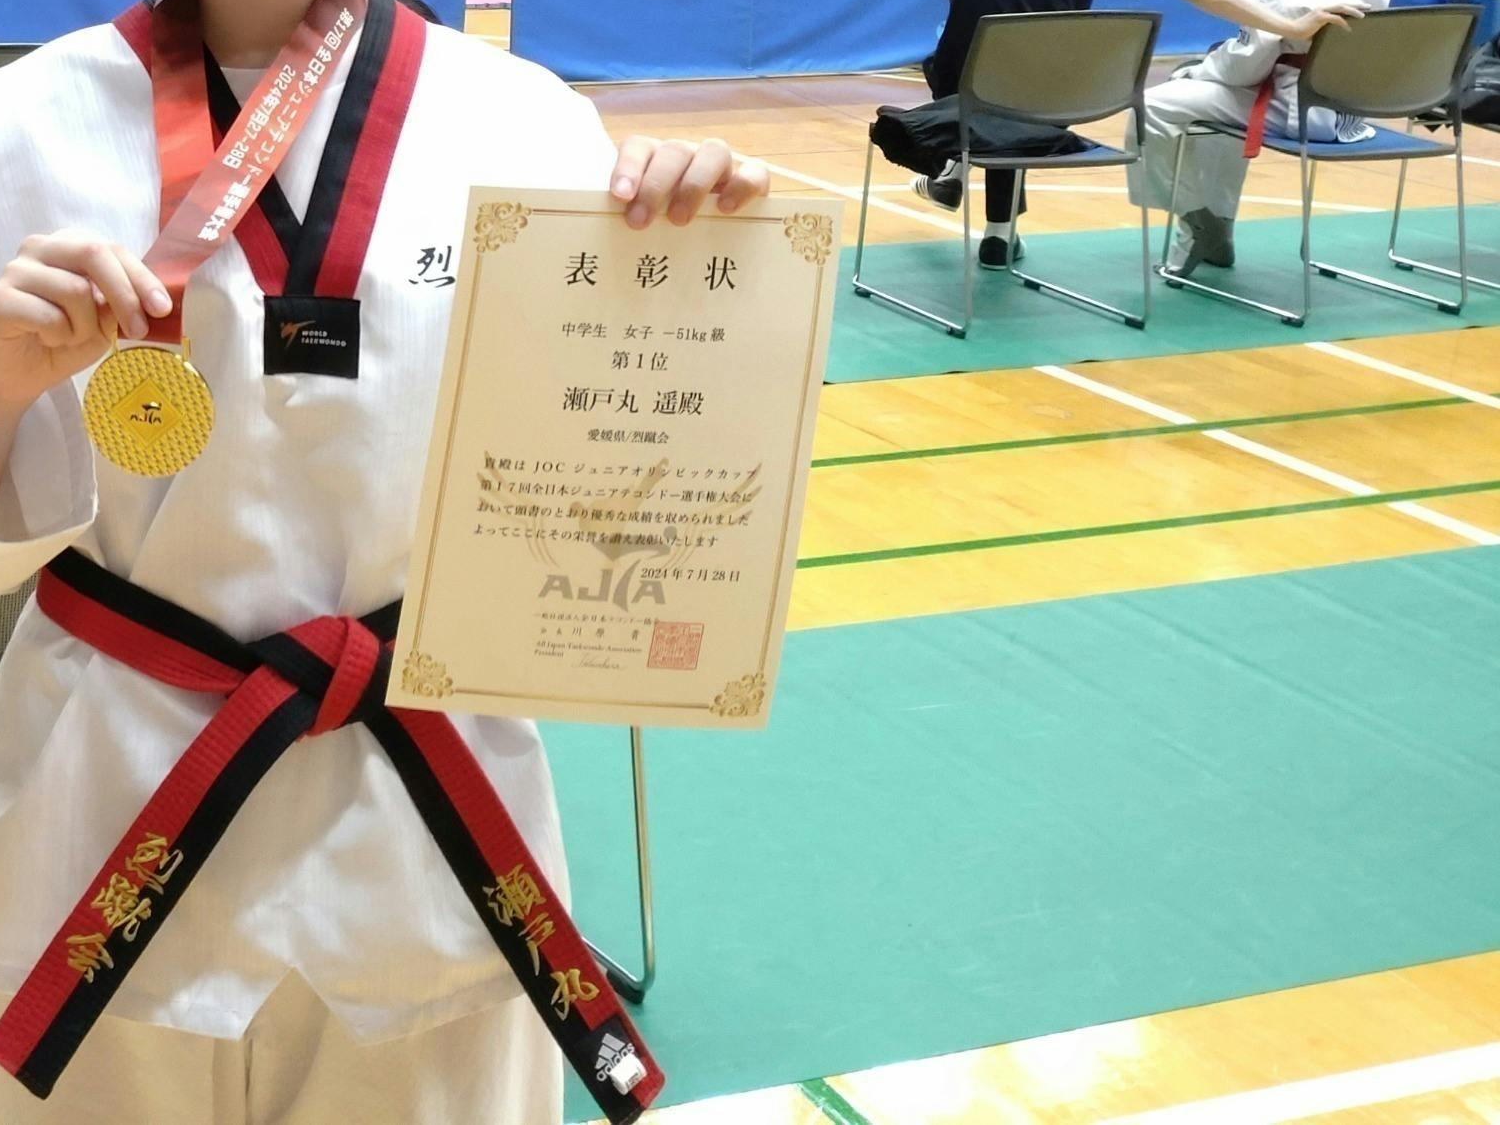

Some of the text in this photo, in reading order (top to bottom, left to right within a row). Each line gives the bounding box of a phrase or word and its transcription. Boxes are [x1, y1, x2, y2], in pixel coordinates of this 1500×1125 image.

[408, 246, 456, 288] 烈
[564, 252, 737, 290] 表彰状
[301, 337, 347, 347] TAEKWONDO
[561, 322, 607, 338] 中学生
[623, 325, 653, 340] 女子
[612, 351, 668, 372] 第1位
[596, 1042, 635, 1081] adidas
